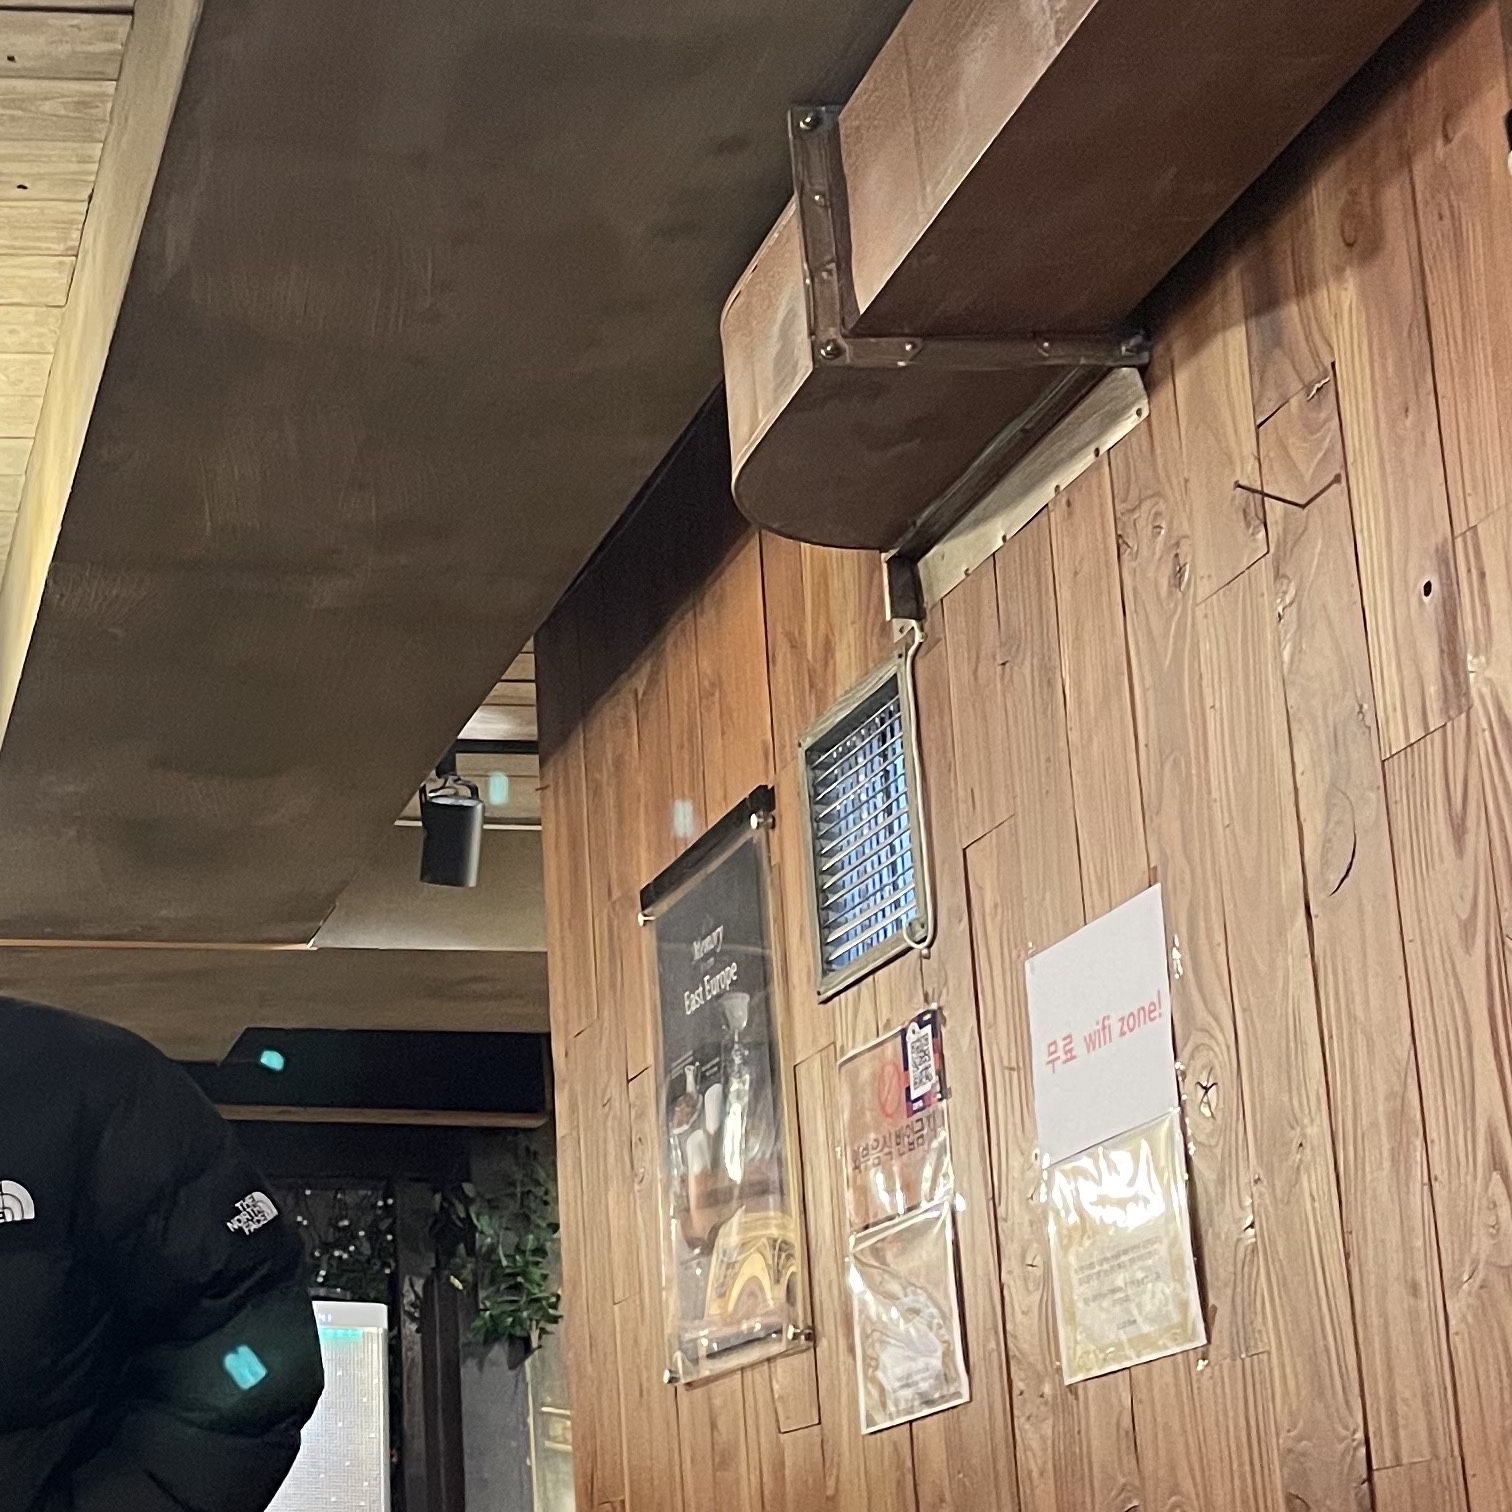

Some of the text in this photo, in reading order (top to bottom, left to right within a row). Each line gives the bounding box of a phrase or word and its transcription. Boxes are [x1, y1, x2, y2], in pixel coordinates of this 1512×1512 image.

[684, 983, 705, 1015] East
[704, 962, 738, 1001] Europe
[1046, 989, 1162, 1074] 무료 wifi zone!
[226, 1203, 259, 1232] NORTH
[234, 1194, 255, 1212] THE
[242, 1213, 267, 1236] FACE
